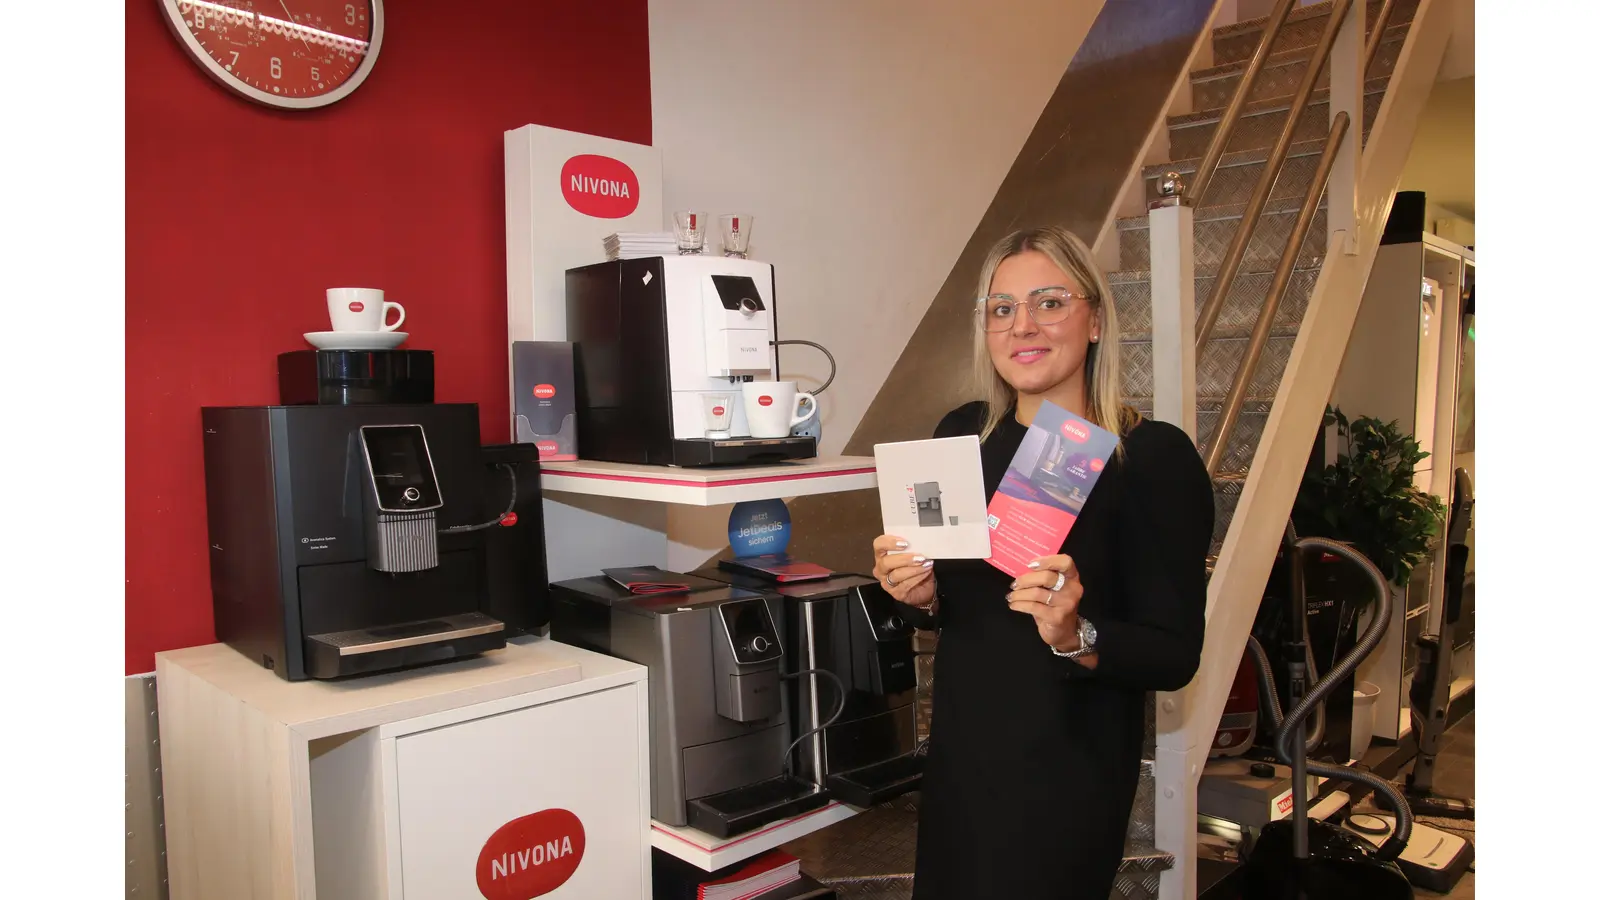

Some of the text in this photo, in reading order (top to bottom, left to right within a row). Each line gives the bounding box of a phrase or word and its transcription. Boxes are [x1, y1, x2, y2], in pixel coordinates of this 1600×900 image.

[195, 13, 205, 29] 8
[345, 4, 355, 25] 3
[229, 51, 239, 65] 7
[270, 57, 281, 79] 6
[311, 67, 320, 81] 5
[571, 173, 630, 199] NIVONA
[1064, 423, 1086, 439] NIVONA
[751, 512, 768, 522] Jetzt
[738, 521, 783, 538] JetDeals
[748, 535, 774, 546] sichern
[492, 835, 573, 881] NIVONA
